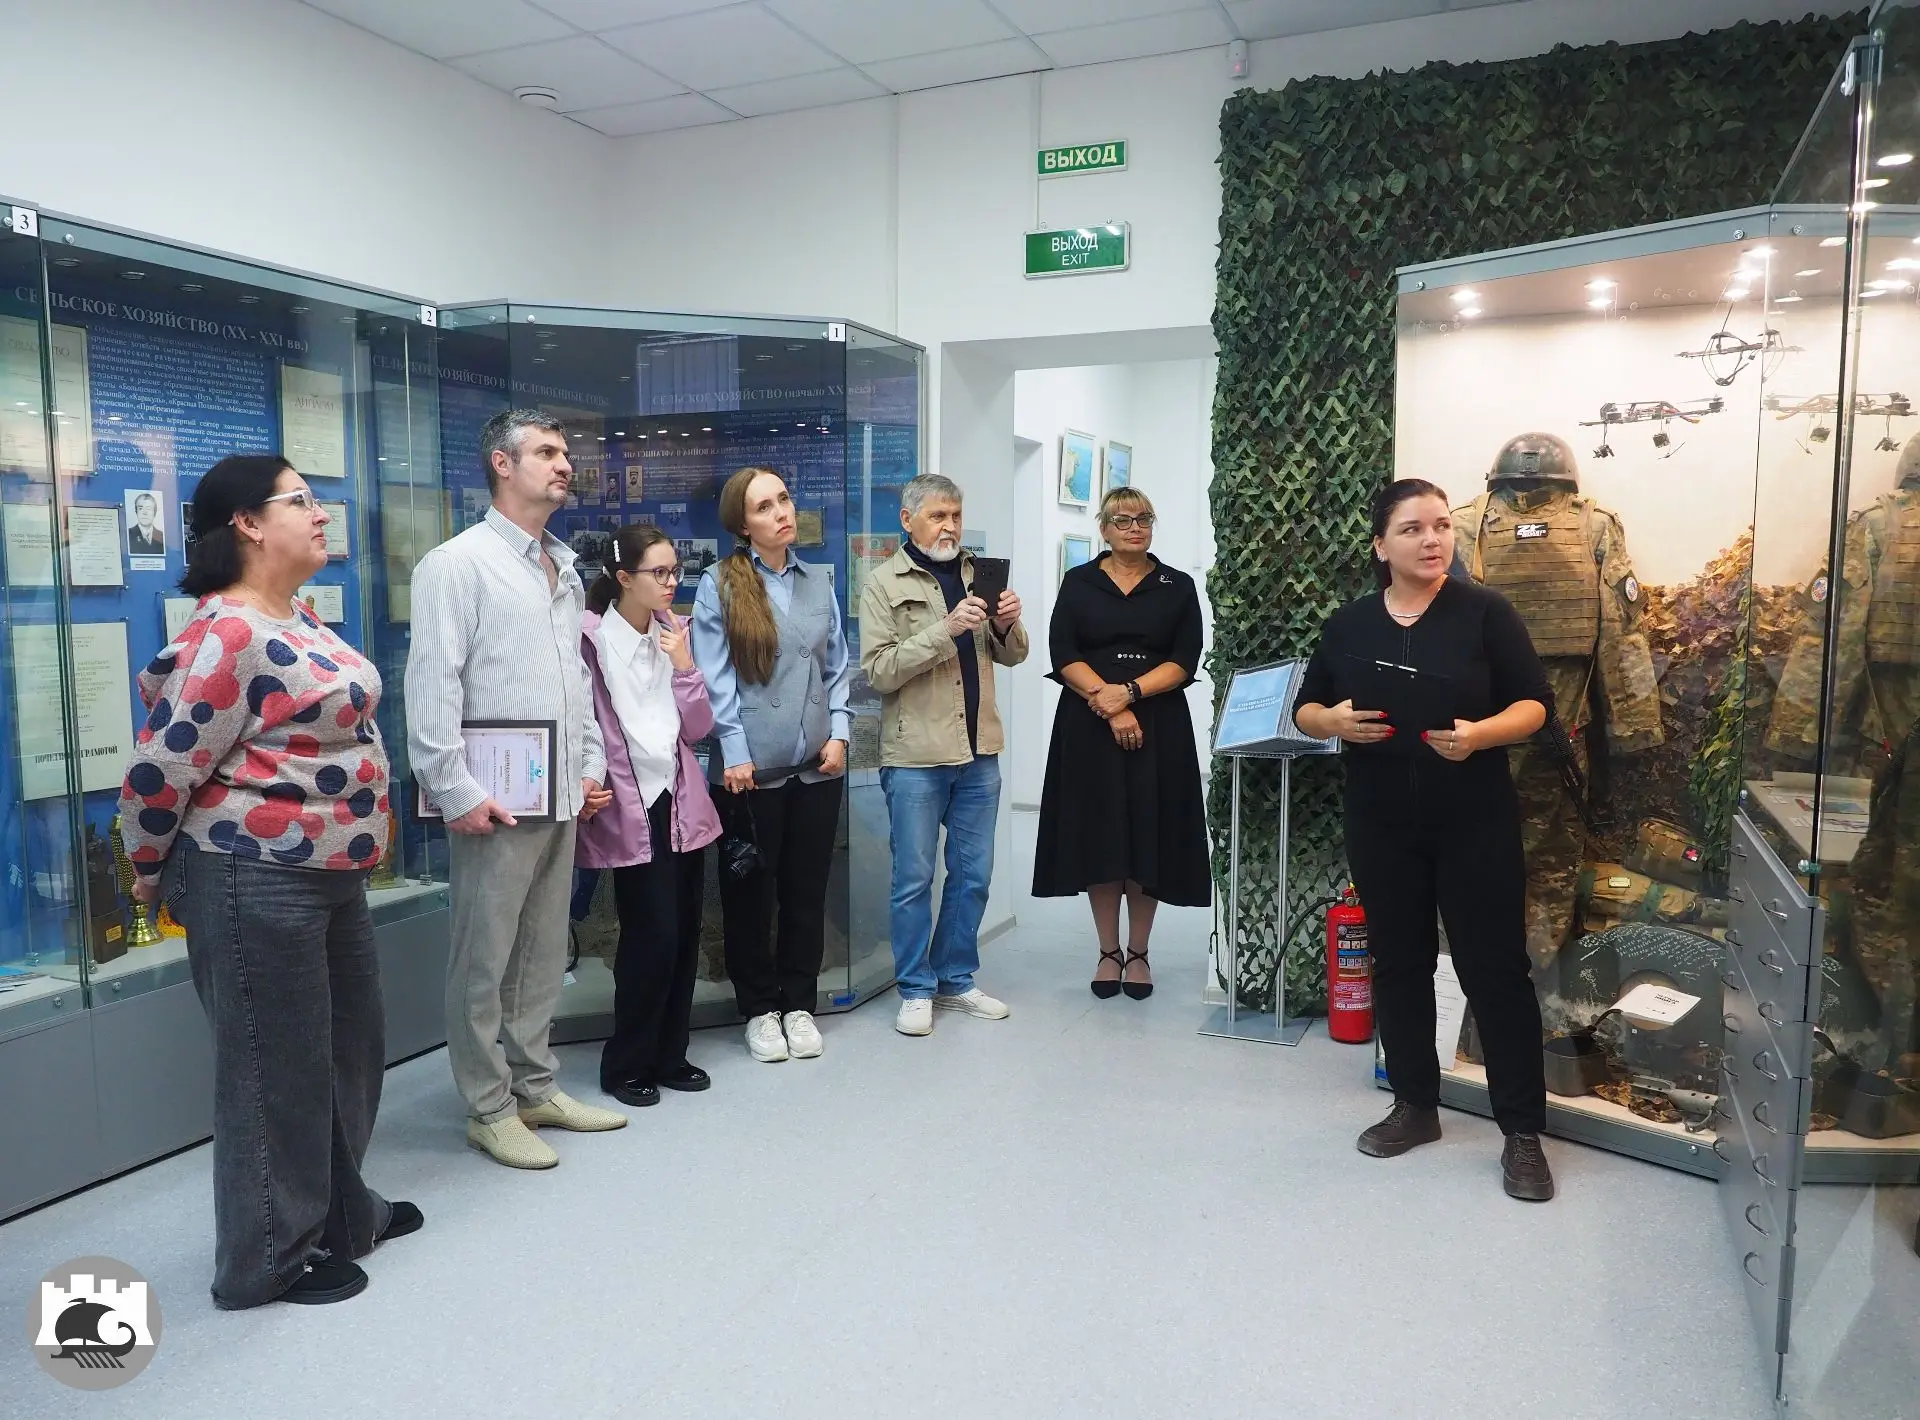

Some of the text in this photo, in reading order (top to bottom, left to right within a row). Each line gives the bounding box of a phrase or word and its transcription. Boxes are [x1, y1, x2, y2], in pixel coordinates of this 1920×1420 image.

[1044, 144, 1117, 169] ВЫХОД
[20, 214, 30, 230] 3
[1051, 233, 1099, 252] ВЫХОД
[1062, 252, 1090, 266] EXIT
[15, 285, 118, 318] СЕЛЬСКОЕ
[122, 302, 219, 336] ХОЗЯЙСТВО
[426, 310, 432, 323] 2
[834, 327, 839, 338] 1
[372, 354, 435, 377] СЕЛЬКОЕ
[435, 365, 498, 388] ХОЗЯЙСТВО
[499, 377, 505, 389] В
[652, 392, 711, 405] СЕЛЬСКОЕ
[713, 387, 783, 403] ХОЗЯЙСТВО
[785, 386, 826, 400] (начало
